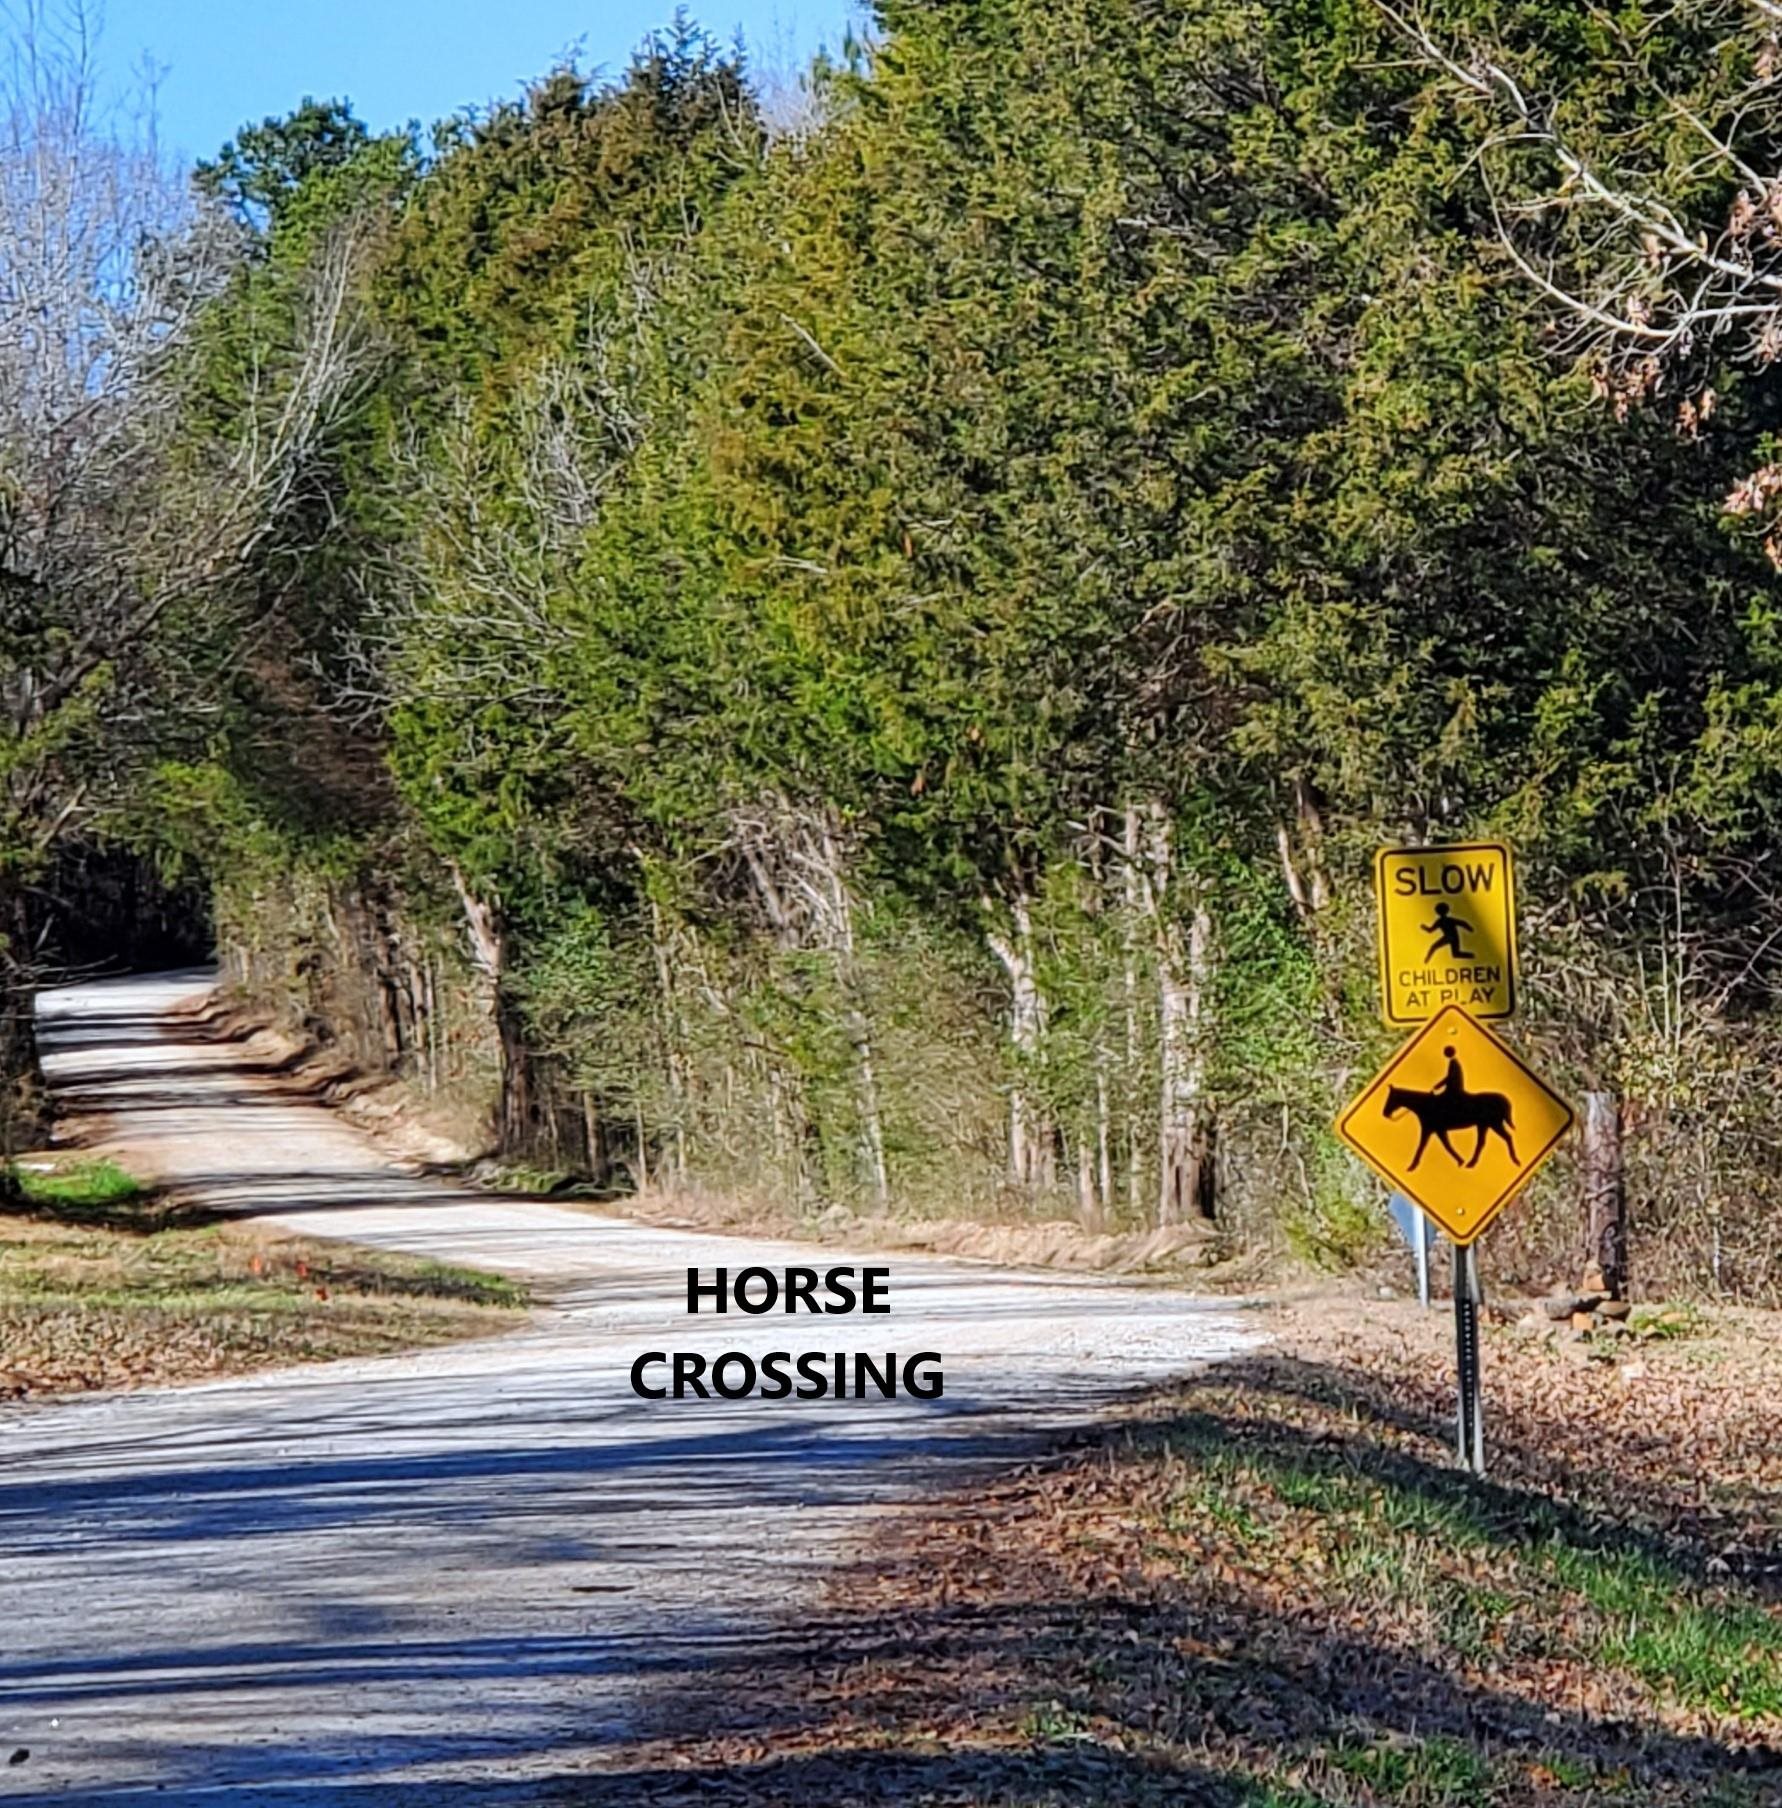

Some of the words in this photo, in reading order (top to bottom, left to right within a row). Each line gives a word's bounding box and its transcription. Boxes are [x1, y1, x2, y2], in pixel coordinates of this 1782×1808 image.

[1394, 863, 1495, 897] SLOW
[1398, 965, 1501, 988] CHILDREN
[1406, 990, 1431, 1008] AT
